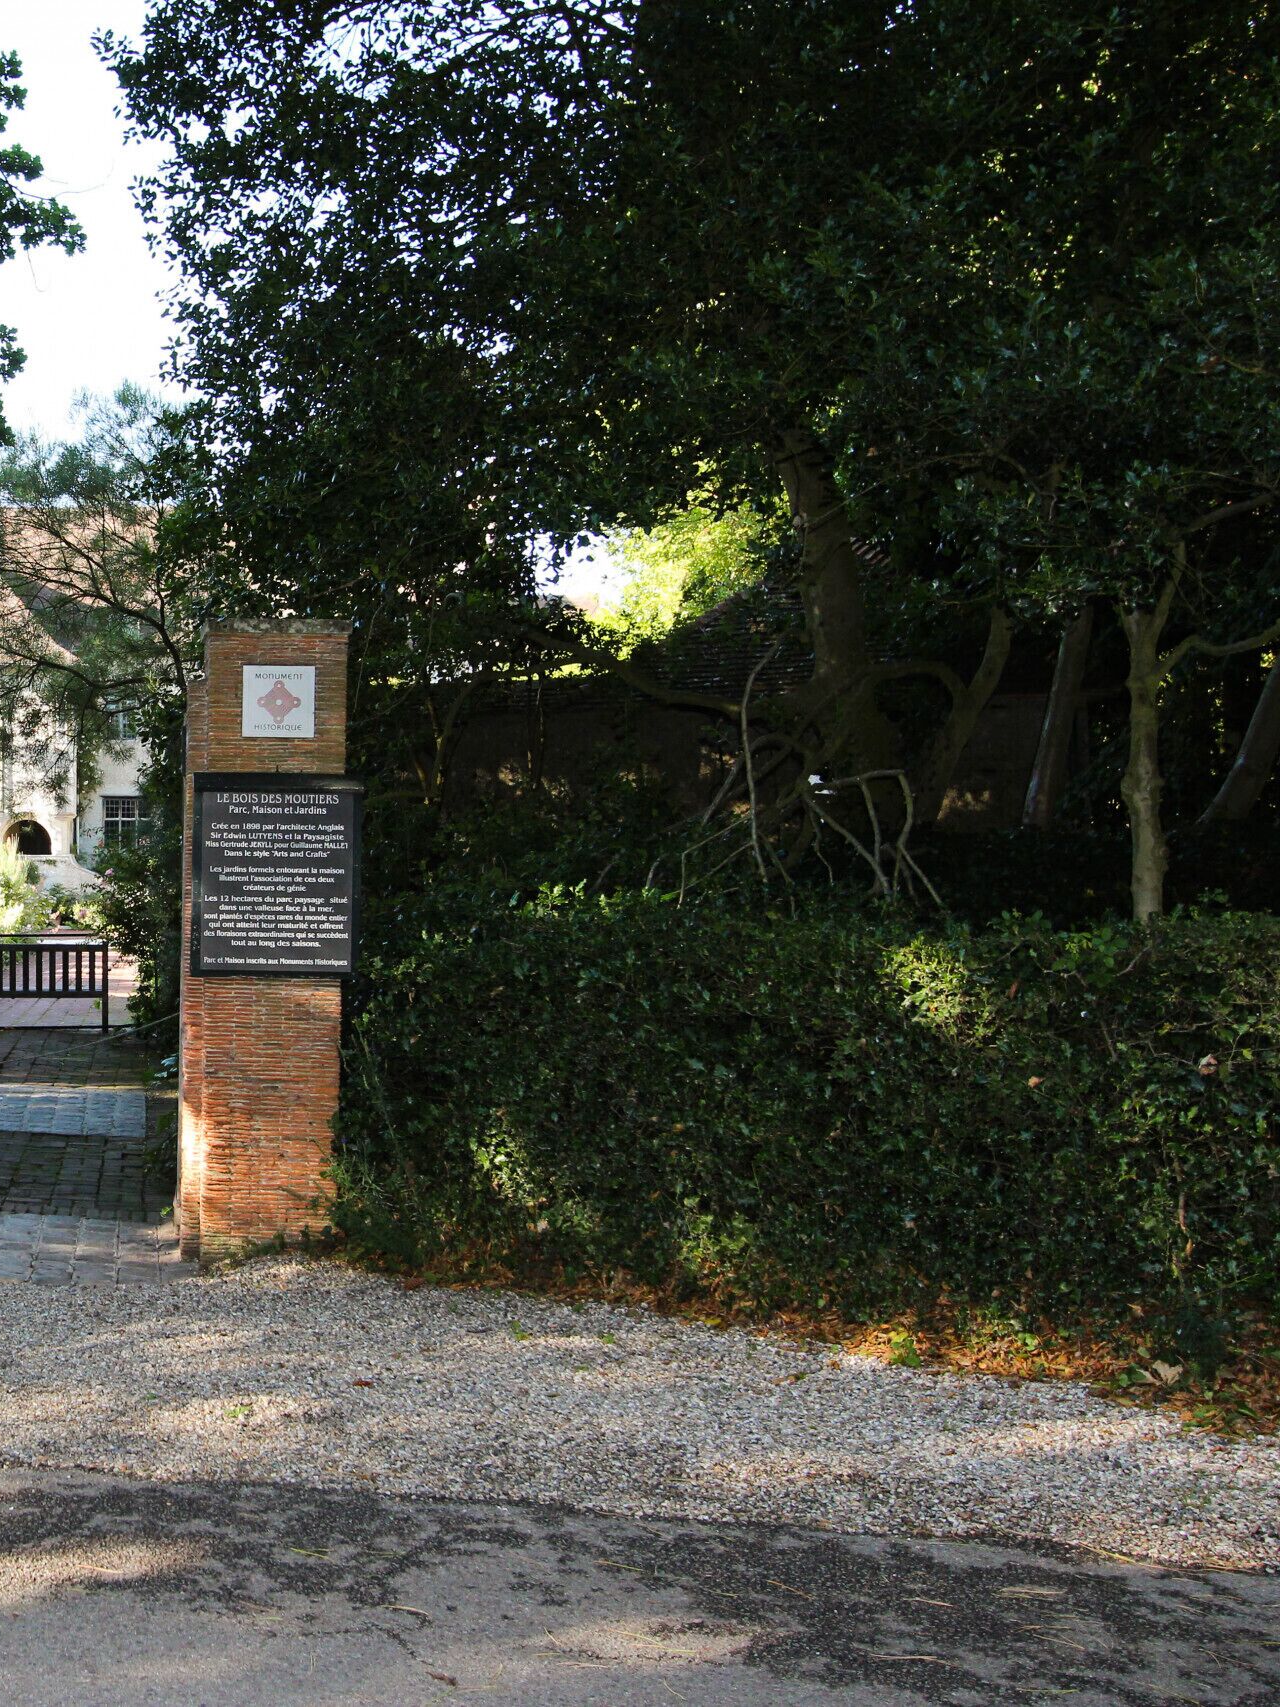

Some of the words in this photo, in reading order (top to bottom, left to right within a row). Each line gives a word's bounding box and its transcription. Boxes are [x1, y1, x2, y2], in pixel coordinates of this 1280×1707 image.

[254, 724, 302, 732] HISTORIQUE
[217, 793, 229, 803] LE
[233, 793, 258, 803] BOIS
[261, 794, 282, 804] DES
[285, 794, 339, 804] MOUTIERS
[229, 805, 250, 814] Parc,
[252, 805, 282, 814] Maison
[295, 806, 327, 815] Jardins
[318, 824, 344, 832] Anglais
[253, 850, 270, 858] style
[223, 866, 247, 874] jardins
[209, 921, 220, 929] qui
[296, 931, 306, 939] qui
[259, 940, 275, 948] long
